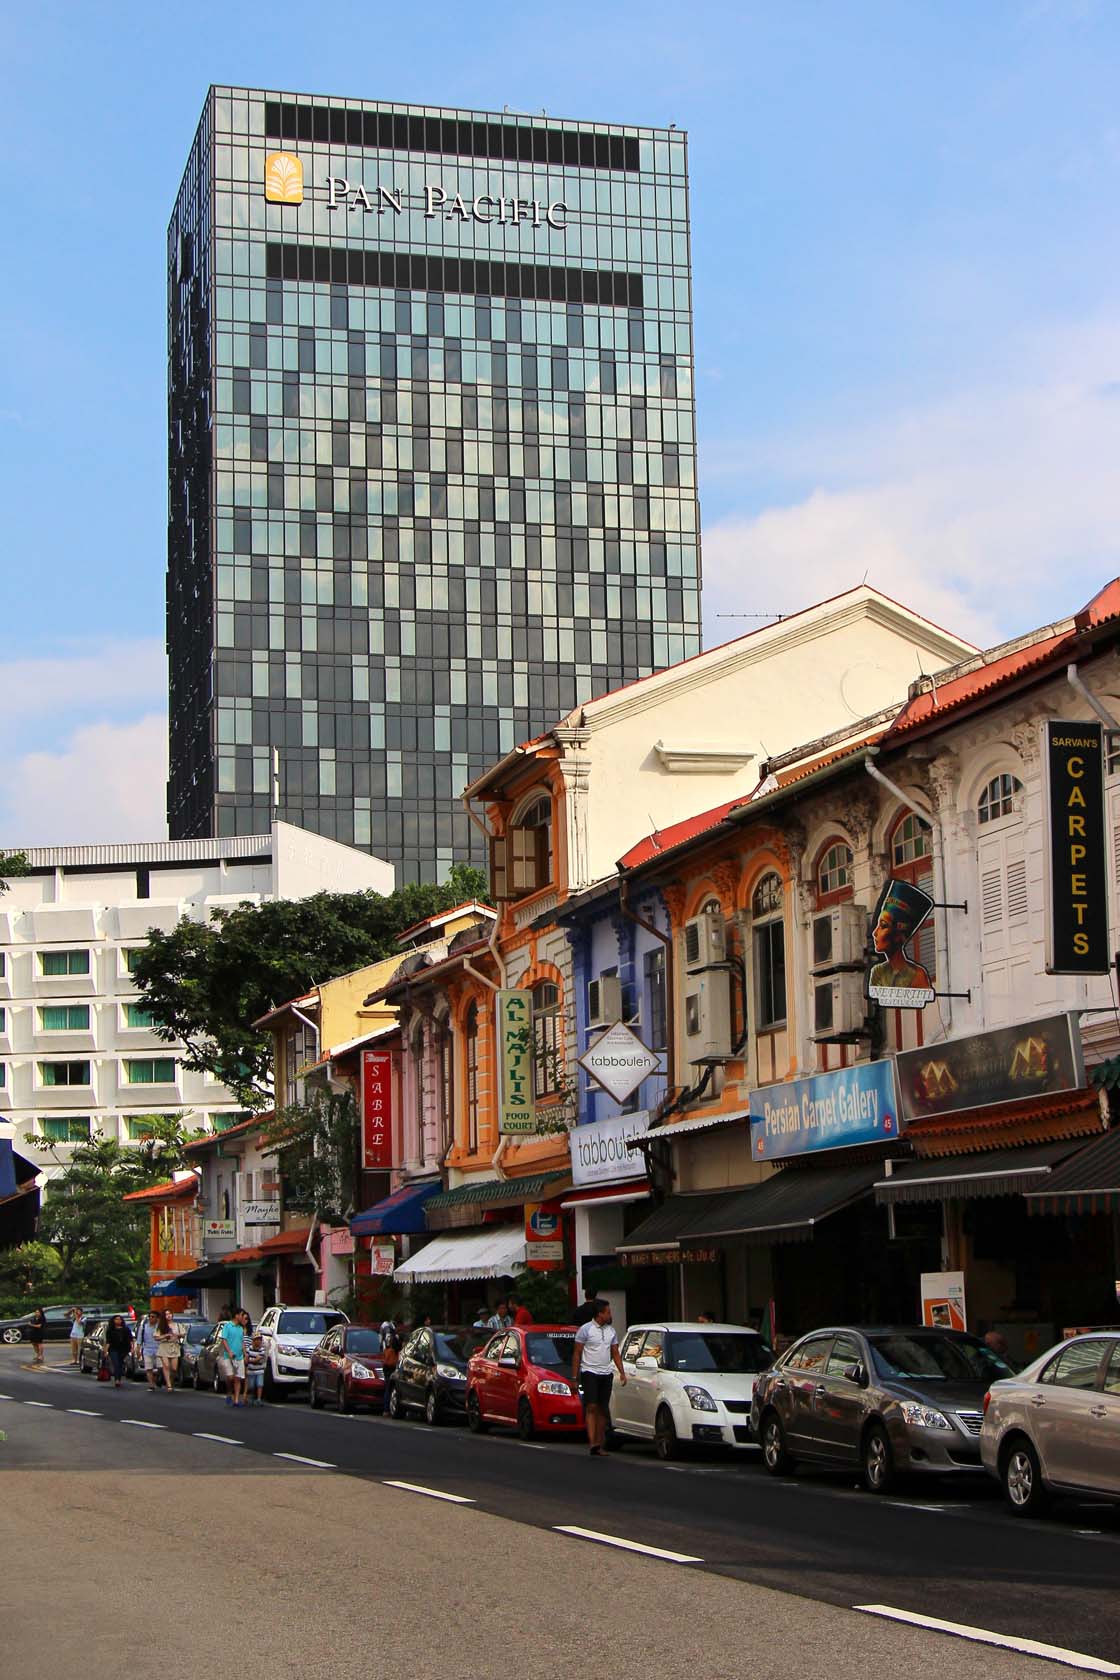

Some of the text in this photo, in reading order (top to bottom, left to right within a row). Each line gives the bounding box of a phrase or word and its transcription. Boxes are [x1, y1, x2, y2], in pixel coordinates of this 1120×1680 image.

[326, 176, 568, 230] PAN PACIFIC
[1052, 737, 1098, 748] SARVAN'S
[1066, 756, 1089, 955] CARPETS
[506, 998, 525, 1021] AL
[506, 1031, 527, 1105] MAJLIS
[591, 1055, 650, 1066] tabbouleh
[371, 1065, 384, 1145] SABRE
[505, 1112, 530, 1120] FOOD
[764, 1082, 878, 1137] Persian Carpet Gallery
[503, 1122, 533, 1130] COURT
[884, 1119, 892, 1129] 45
